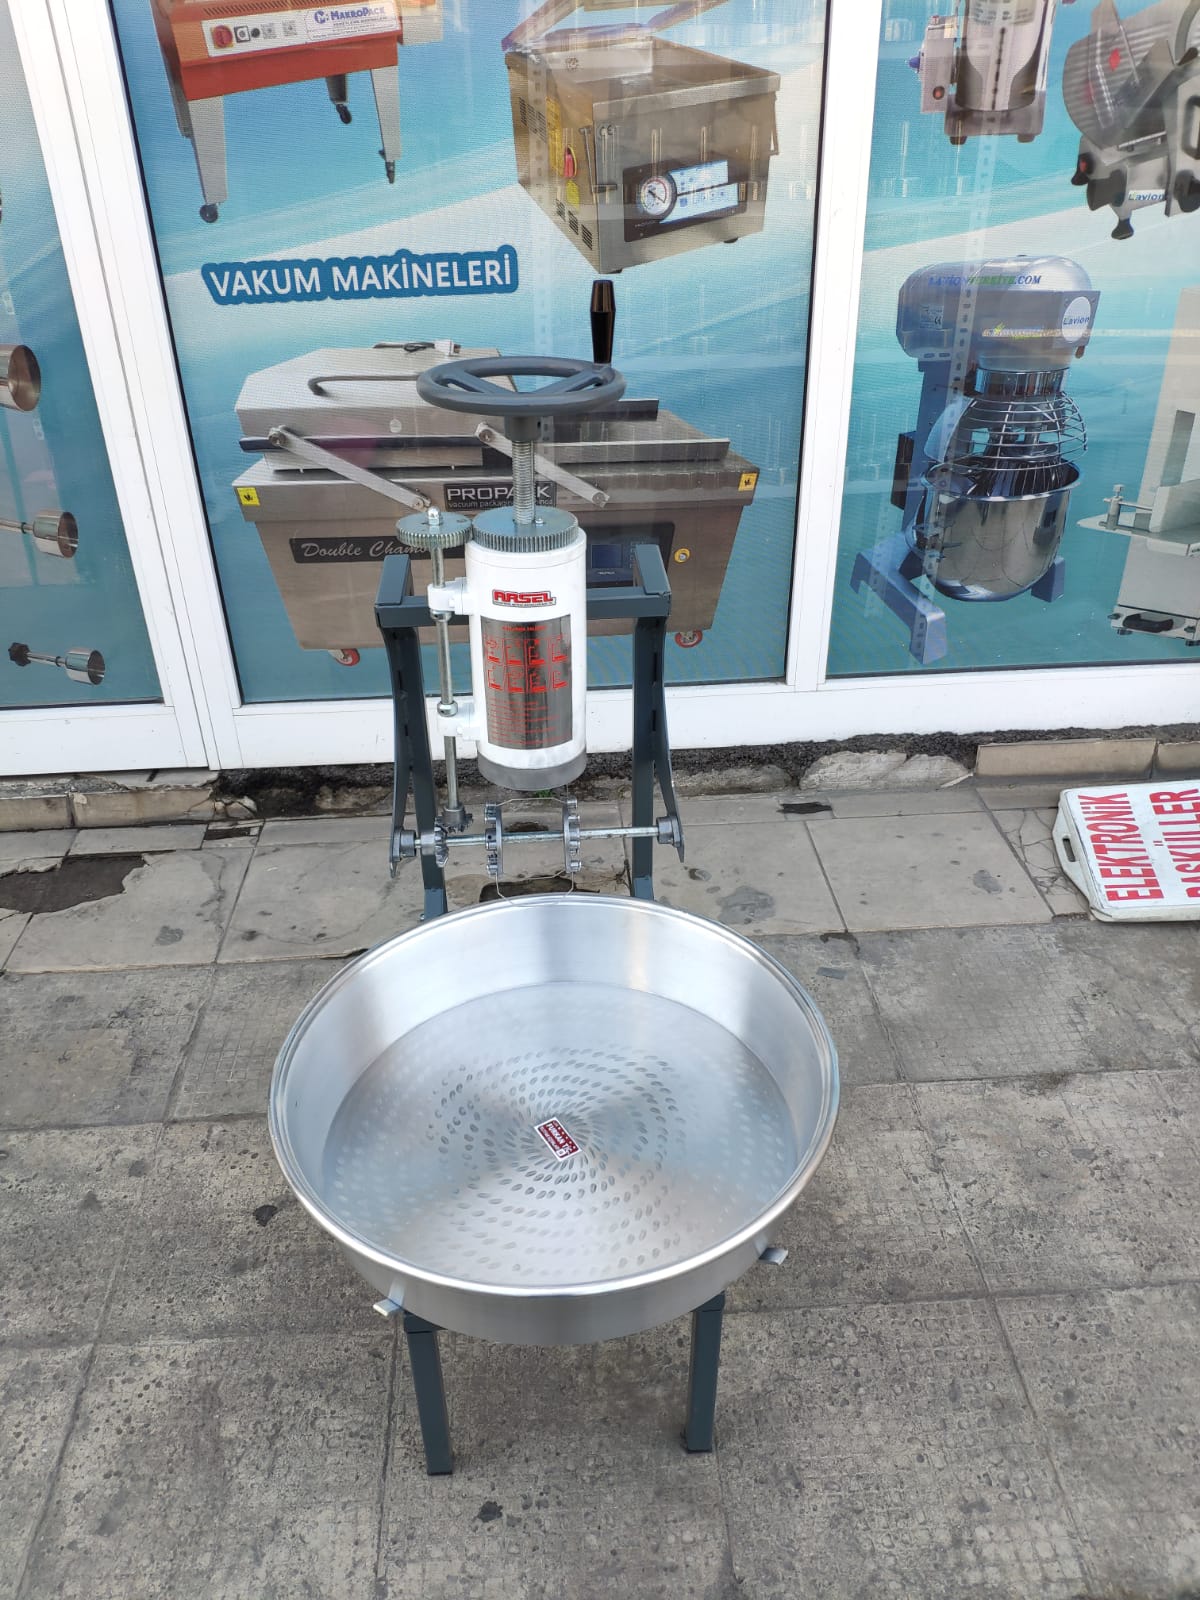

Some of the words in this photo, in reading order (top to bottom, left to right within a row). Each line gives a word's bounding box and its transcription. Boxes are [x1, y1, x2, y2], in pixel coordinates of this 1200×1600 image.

[210, 267, 321, 297] VAKUM
[332, 253, 512, 293] MAKİNELERİ
[1063, 316, 1090, 326] Lavion
[447, 486, 551, 500] PROPK
[301, 542, 362, 557] Double
[369, 541, 427, 557] Cham
[1078, 793, 1164, 901] ELEKTRONİK
[1149, 788, 1200, 898] KÜLLER
